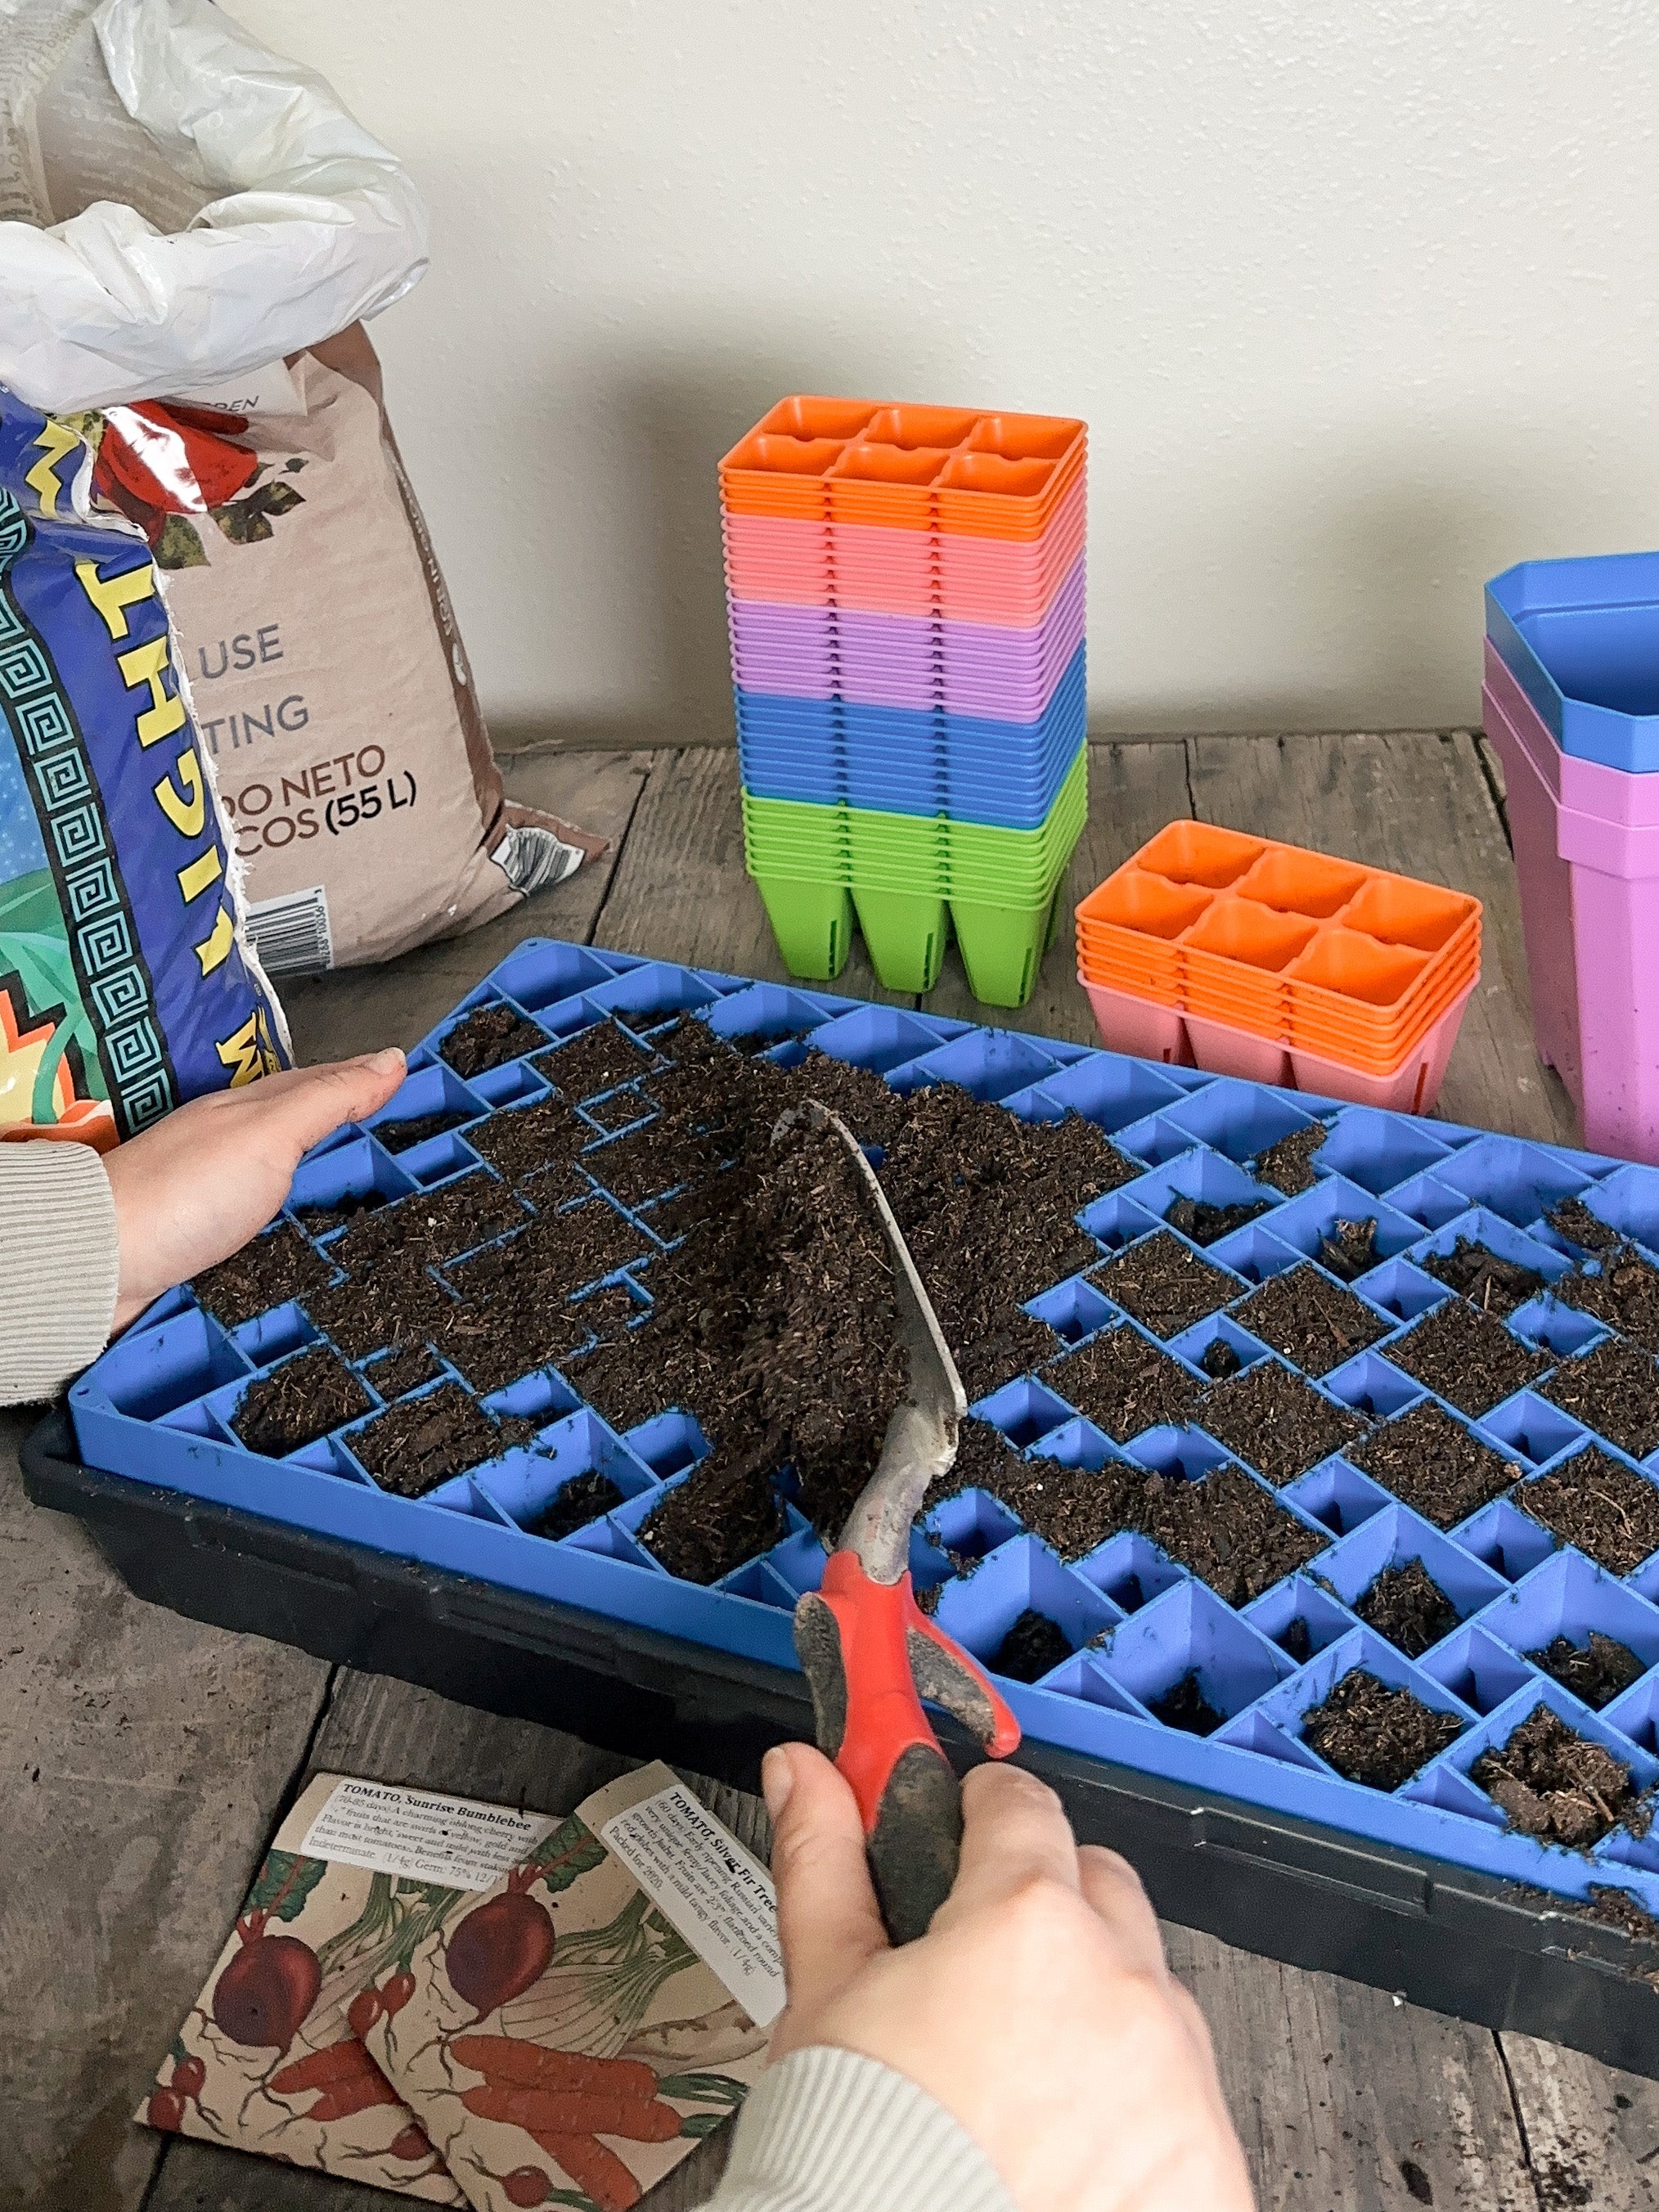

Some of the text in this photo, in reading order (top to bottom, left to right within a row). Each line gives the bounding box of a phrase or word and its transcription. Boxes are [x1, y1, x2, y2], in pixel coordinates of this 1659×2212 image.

[203, 394, 260, 412] DEN
[198, 623, 284, 679] USE
[201, 695, 309, 755] TING
[75, 559, 236, 978] LIGHT
[281, 744, 385, 807] NETO
[234, 770, 416, 858] COS (55 L)
[314, 1824, 337, 1837] than
[321, 1813, 354, 1828] Flavor
[396, 1832, 425, 1842] sweet
[343, 1783, 532, 1831] TOMATO, Sunrise Bumblebee
[371, 1814, 392, 1824] that
[392, 1819, 409, 1828] are
[483, 1840, 509, 1850] gold
[609, 1825, 637, 1857] Packed
[631, 1852, 645, 1868] for
[619, 1819, 637, 1833] red
[652, 1855, 671, 1874] with
[672, 1878, 694, 1900] mild
[688, 1897, 711, 1922] tangy
[644, 1805, 662, 1823] very
[658, 1823, 684, 1848] unique
[717, 1889, 744, 1917] foliage
[739, 1916, 760, 1934] and
[669, 1792, 777, 1914] TOMATO, Silver Fir Tree
[682, 1830, 704, 1852] Early
[729, 1881, 762, 1914] Russian
[631, 1811, 658, 1840] growth
[673, 1859, 696, 1883] Fruits
[692, 1882, 708, 1895] are
[752, 1951, 780, 1978] round
